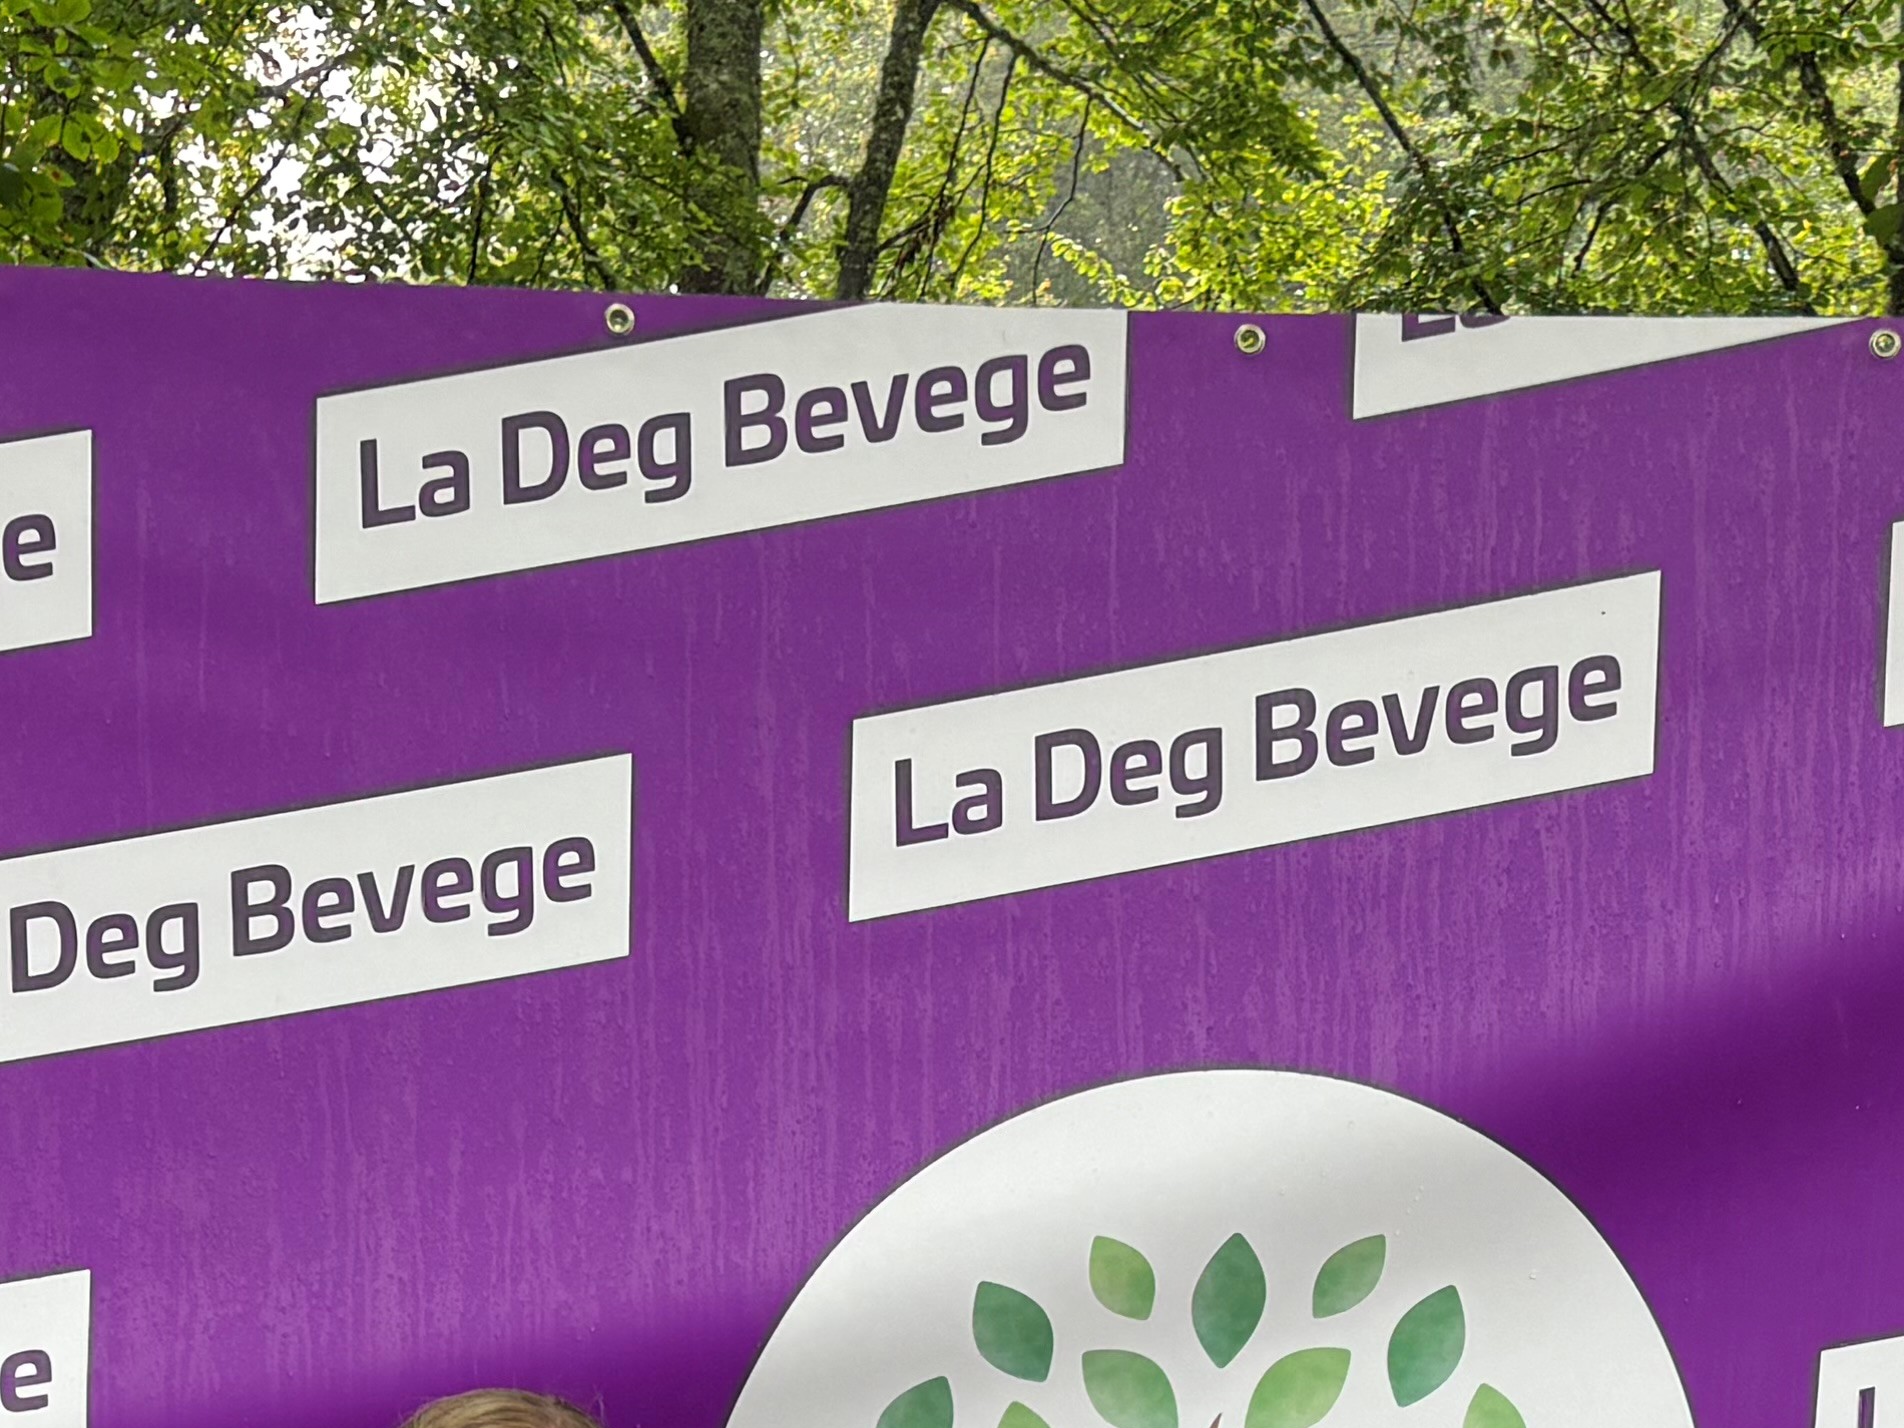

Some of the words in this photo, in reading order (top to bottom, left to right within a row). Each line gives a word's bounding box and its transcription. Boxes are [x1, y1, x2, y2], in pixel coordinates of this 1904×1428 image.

[360, 439, 470, 528] La
[502, 411, 691, 505] Deg
[724, 345, 1090, 467] Bevege
[895, 759, 1002, 847] La
[1035, 728, 1222, 821] Deg
[1256, 655, 1621, 781] Bevege
[10, 901, 199, 993] Deg
[231, 837, 595, 956] Bevege
